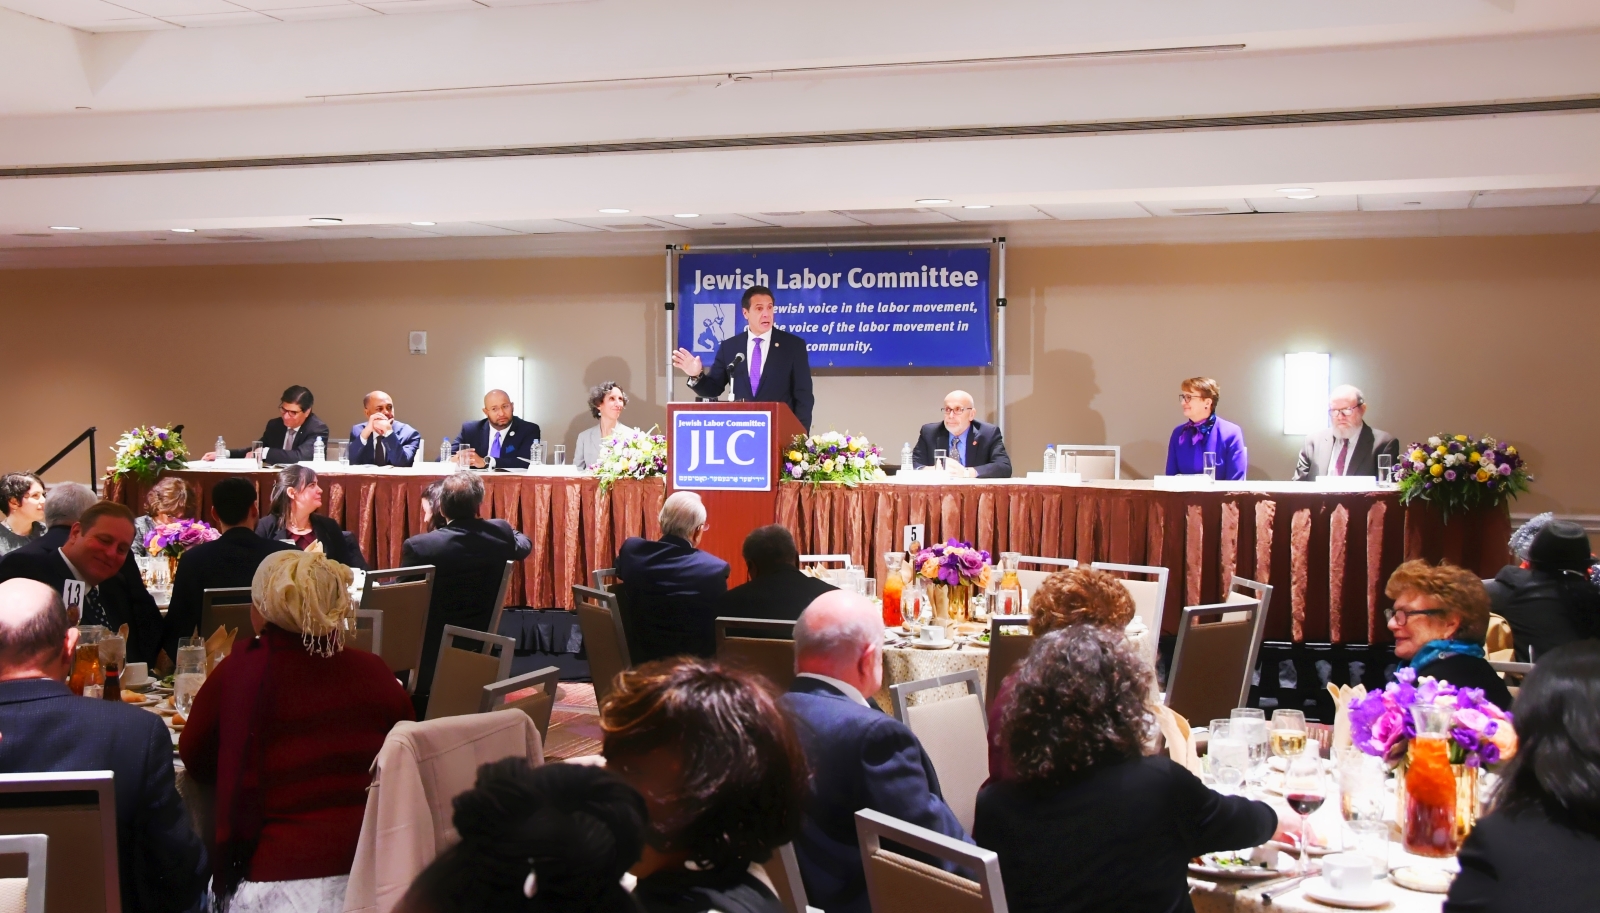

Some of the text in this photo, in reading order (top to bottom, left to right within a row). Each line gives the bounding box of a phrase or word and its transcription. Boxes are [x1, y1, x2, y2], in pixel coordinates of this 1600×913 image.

[693, 265, 979, 294] Jewish Labor Committee
[773, 302, 978, 314] ewish voice in the labor movement,
[789, 322, 820, 333] voice
[821, 321, 835, 335] of
[836, 321, 855, 333] the
[858, 321, 890, 332] labor
[892, 321, 954, 332] movement
[957, 321, 969, 332] in
[806, 340, 873, 354] community.
[678, 419, 766, 428] Jewish Labor Committee
[687, 429, 756, 472] JLC
[911, 526, 917, 541] 5
[67, 582, 81, 606] 13
